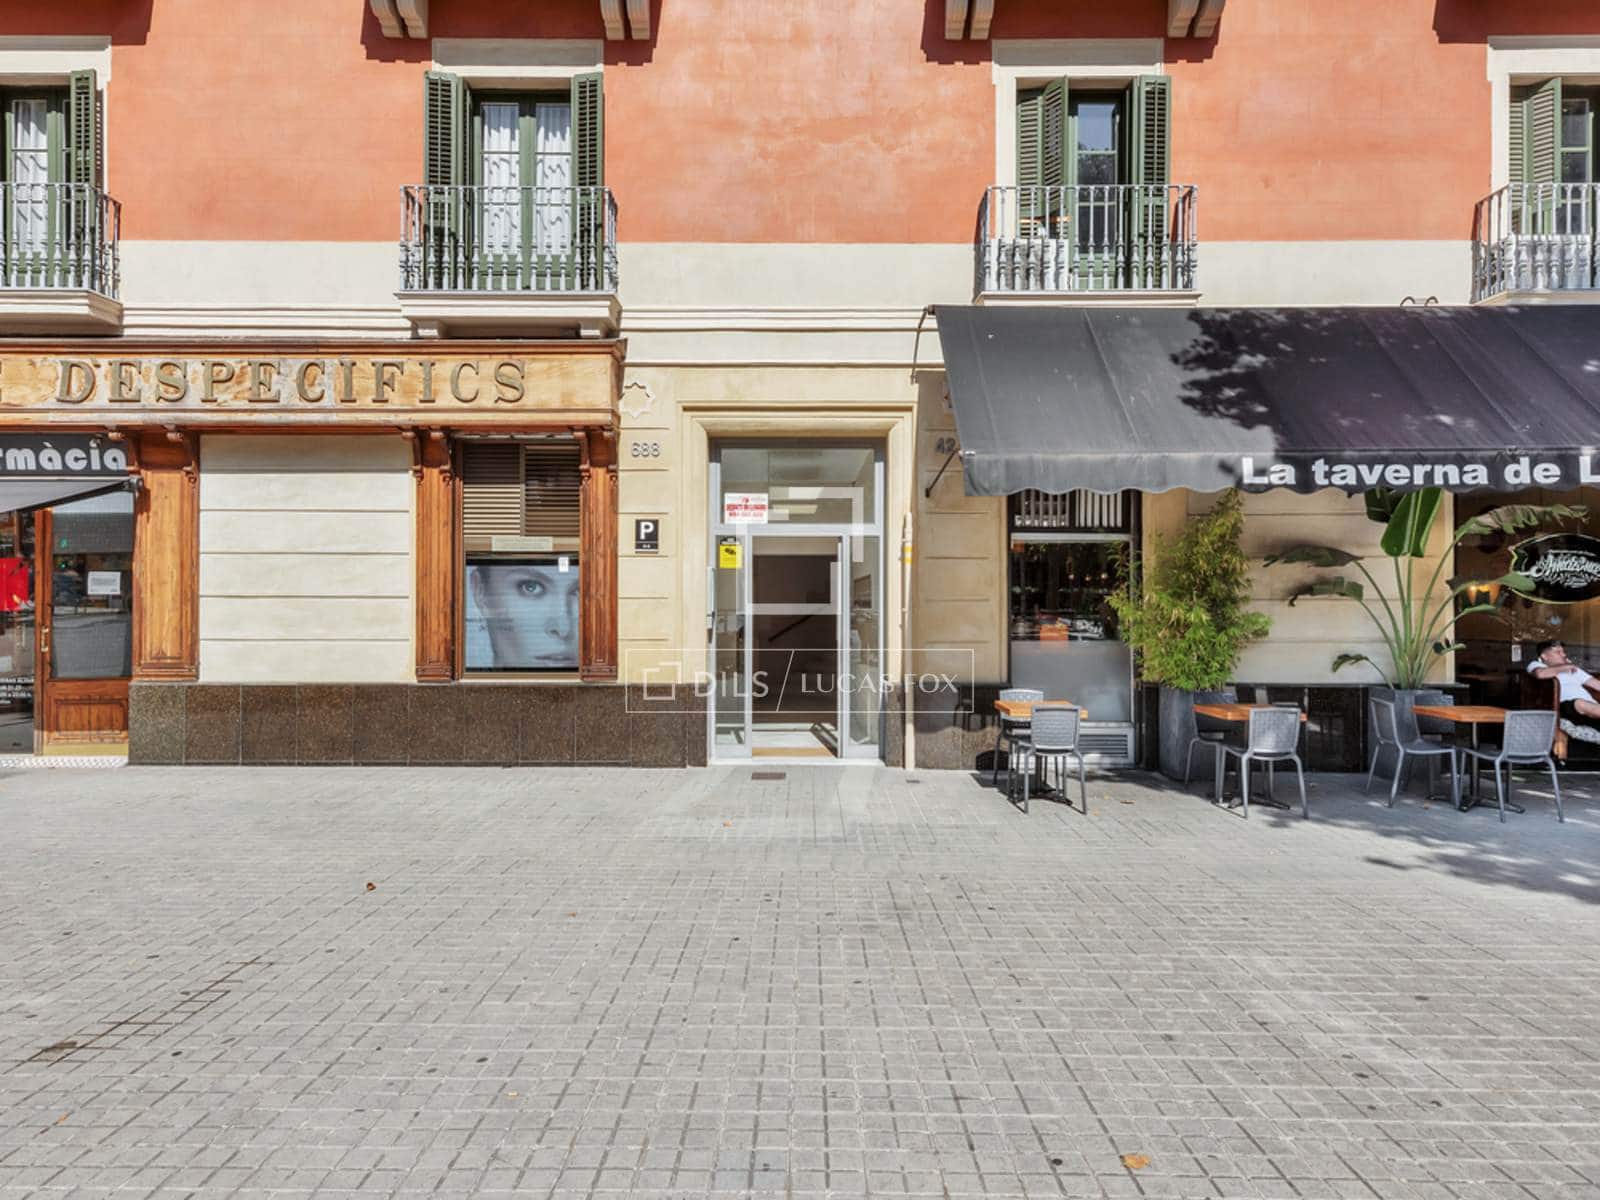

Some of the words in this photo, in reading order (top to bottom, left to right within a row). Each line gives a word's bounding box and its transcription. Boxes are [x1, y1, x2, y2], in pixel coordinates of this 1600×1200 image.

[55, 359, 527, 404] DESPECIFICS
[631, 442, 660, 458] 688
[1241, 456, 1296, 486] La
[1311, 458, 1489, 486] taverna
[1503, 456, 1561, 486] de
[1579, 455, 1600, 485] L
[639, 521, 655, 540] P
